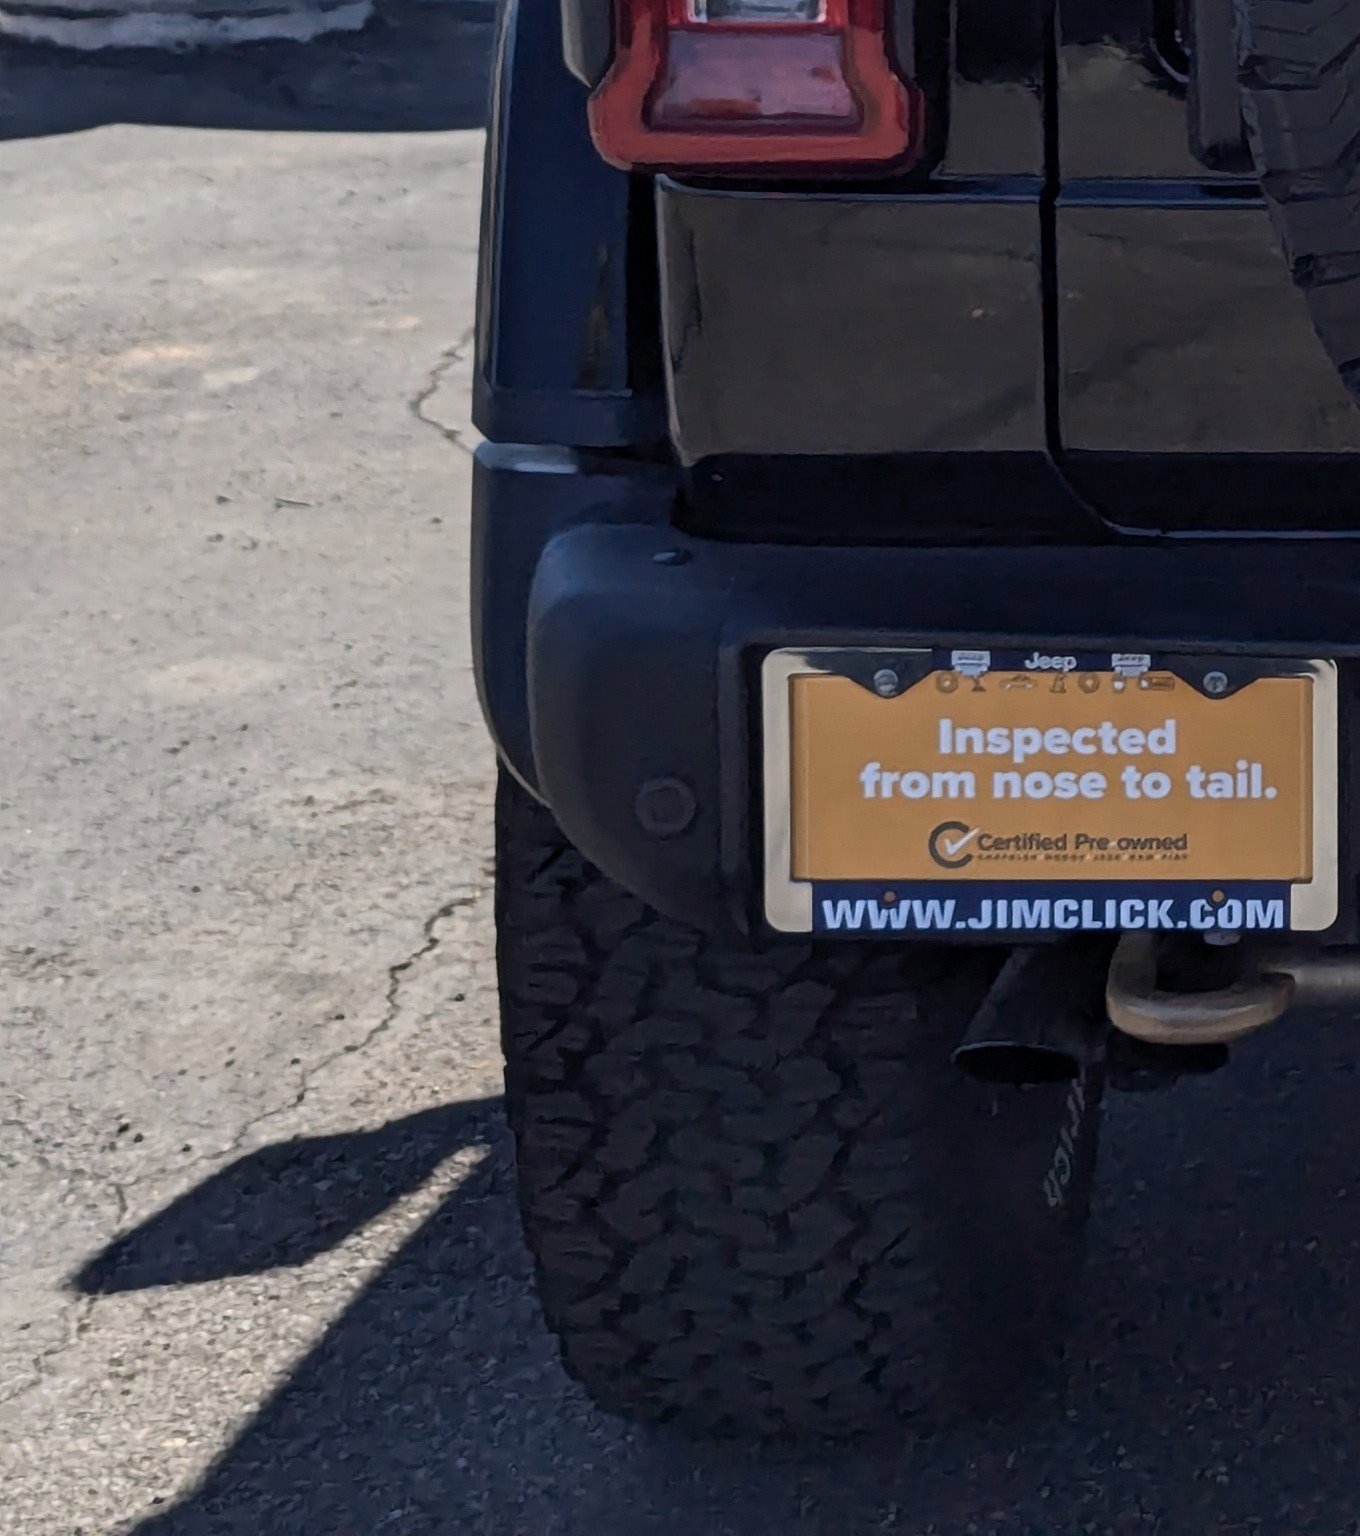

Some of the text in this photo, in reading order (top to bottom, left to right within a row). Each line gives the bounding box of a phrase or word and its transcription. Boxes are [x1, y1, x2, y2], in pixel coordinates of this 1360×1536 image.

[1025, 651, 1077, 673] Jeep
[938, 718, 1177, 764] Inspected
[860, 759, 1279, 800] from nose to tail.
[977, 832, 1068, 851] Certified
[821, 898, 1285, 930] WWW.JIMCLICK.COM
